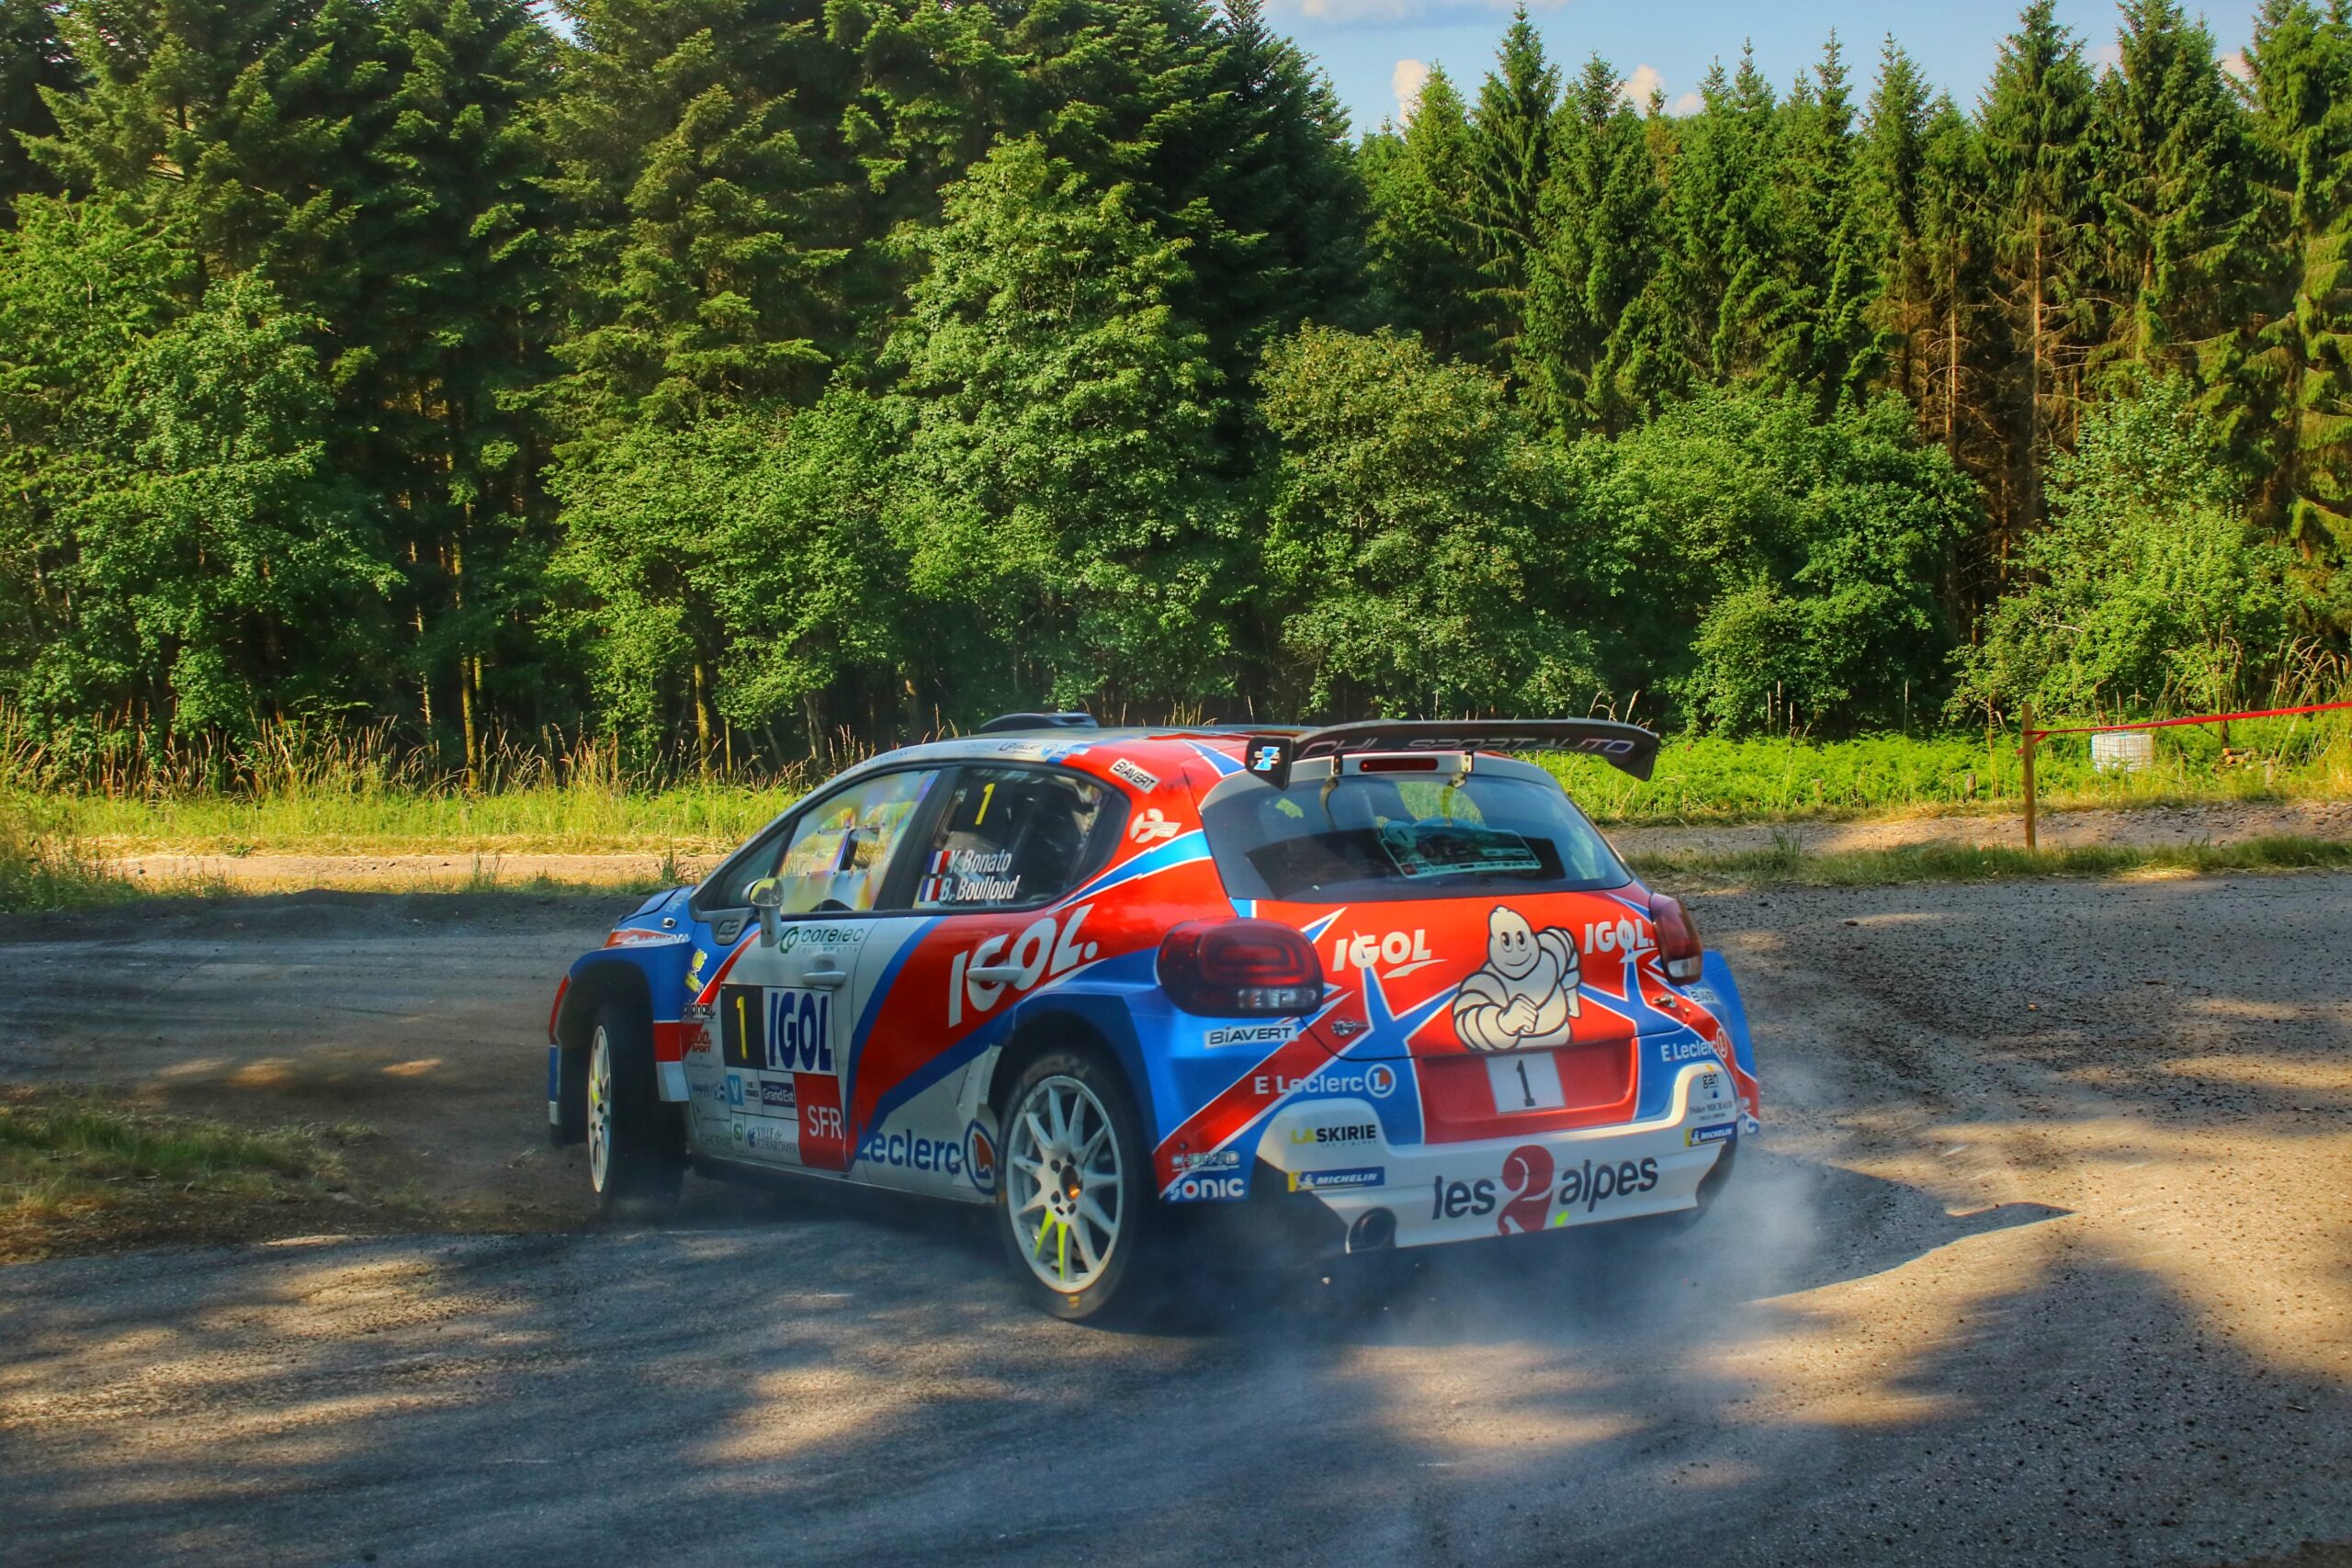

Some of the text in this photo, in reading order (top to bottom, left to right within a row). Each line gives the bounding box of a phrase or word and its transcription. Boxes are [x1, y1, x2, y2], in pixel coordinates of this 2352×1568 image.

[1300, 738, 1635, 759] CHL SPORT AUTO
[975, 783, 995, 825] 1
[962, 849, 1012, 873] Bonato
[939, 874, 1021, 901] B. Boulloud
[801, 925, 864, 942] corelec
[736, 995, 749, 1059] 1
[769, 991, 831, 1071] IGOL
[1516, 1059, 1535, 1107] 1
[1702, 1073, 1719, 1089] gan
[807, 1104, 842, 1140] SFR
[1171, 1151, 1239, 1167] CHOPARD
[1316, 1172, 1378, 1185] MICHELIN
[1431, 1145, 1659, 1235] les 2 alpes
